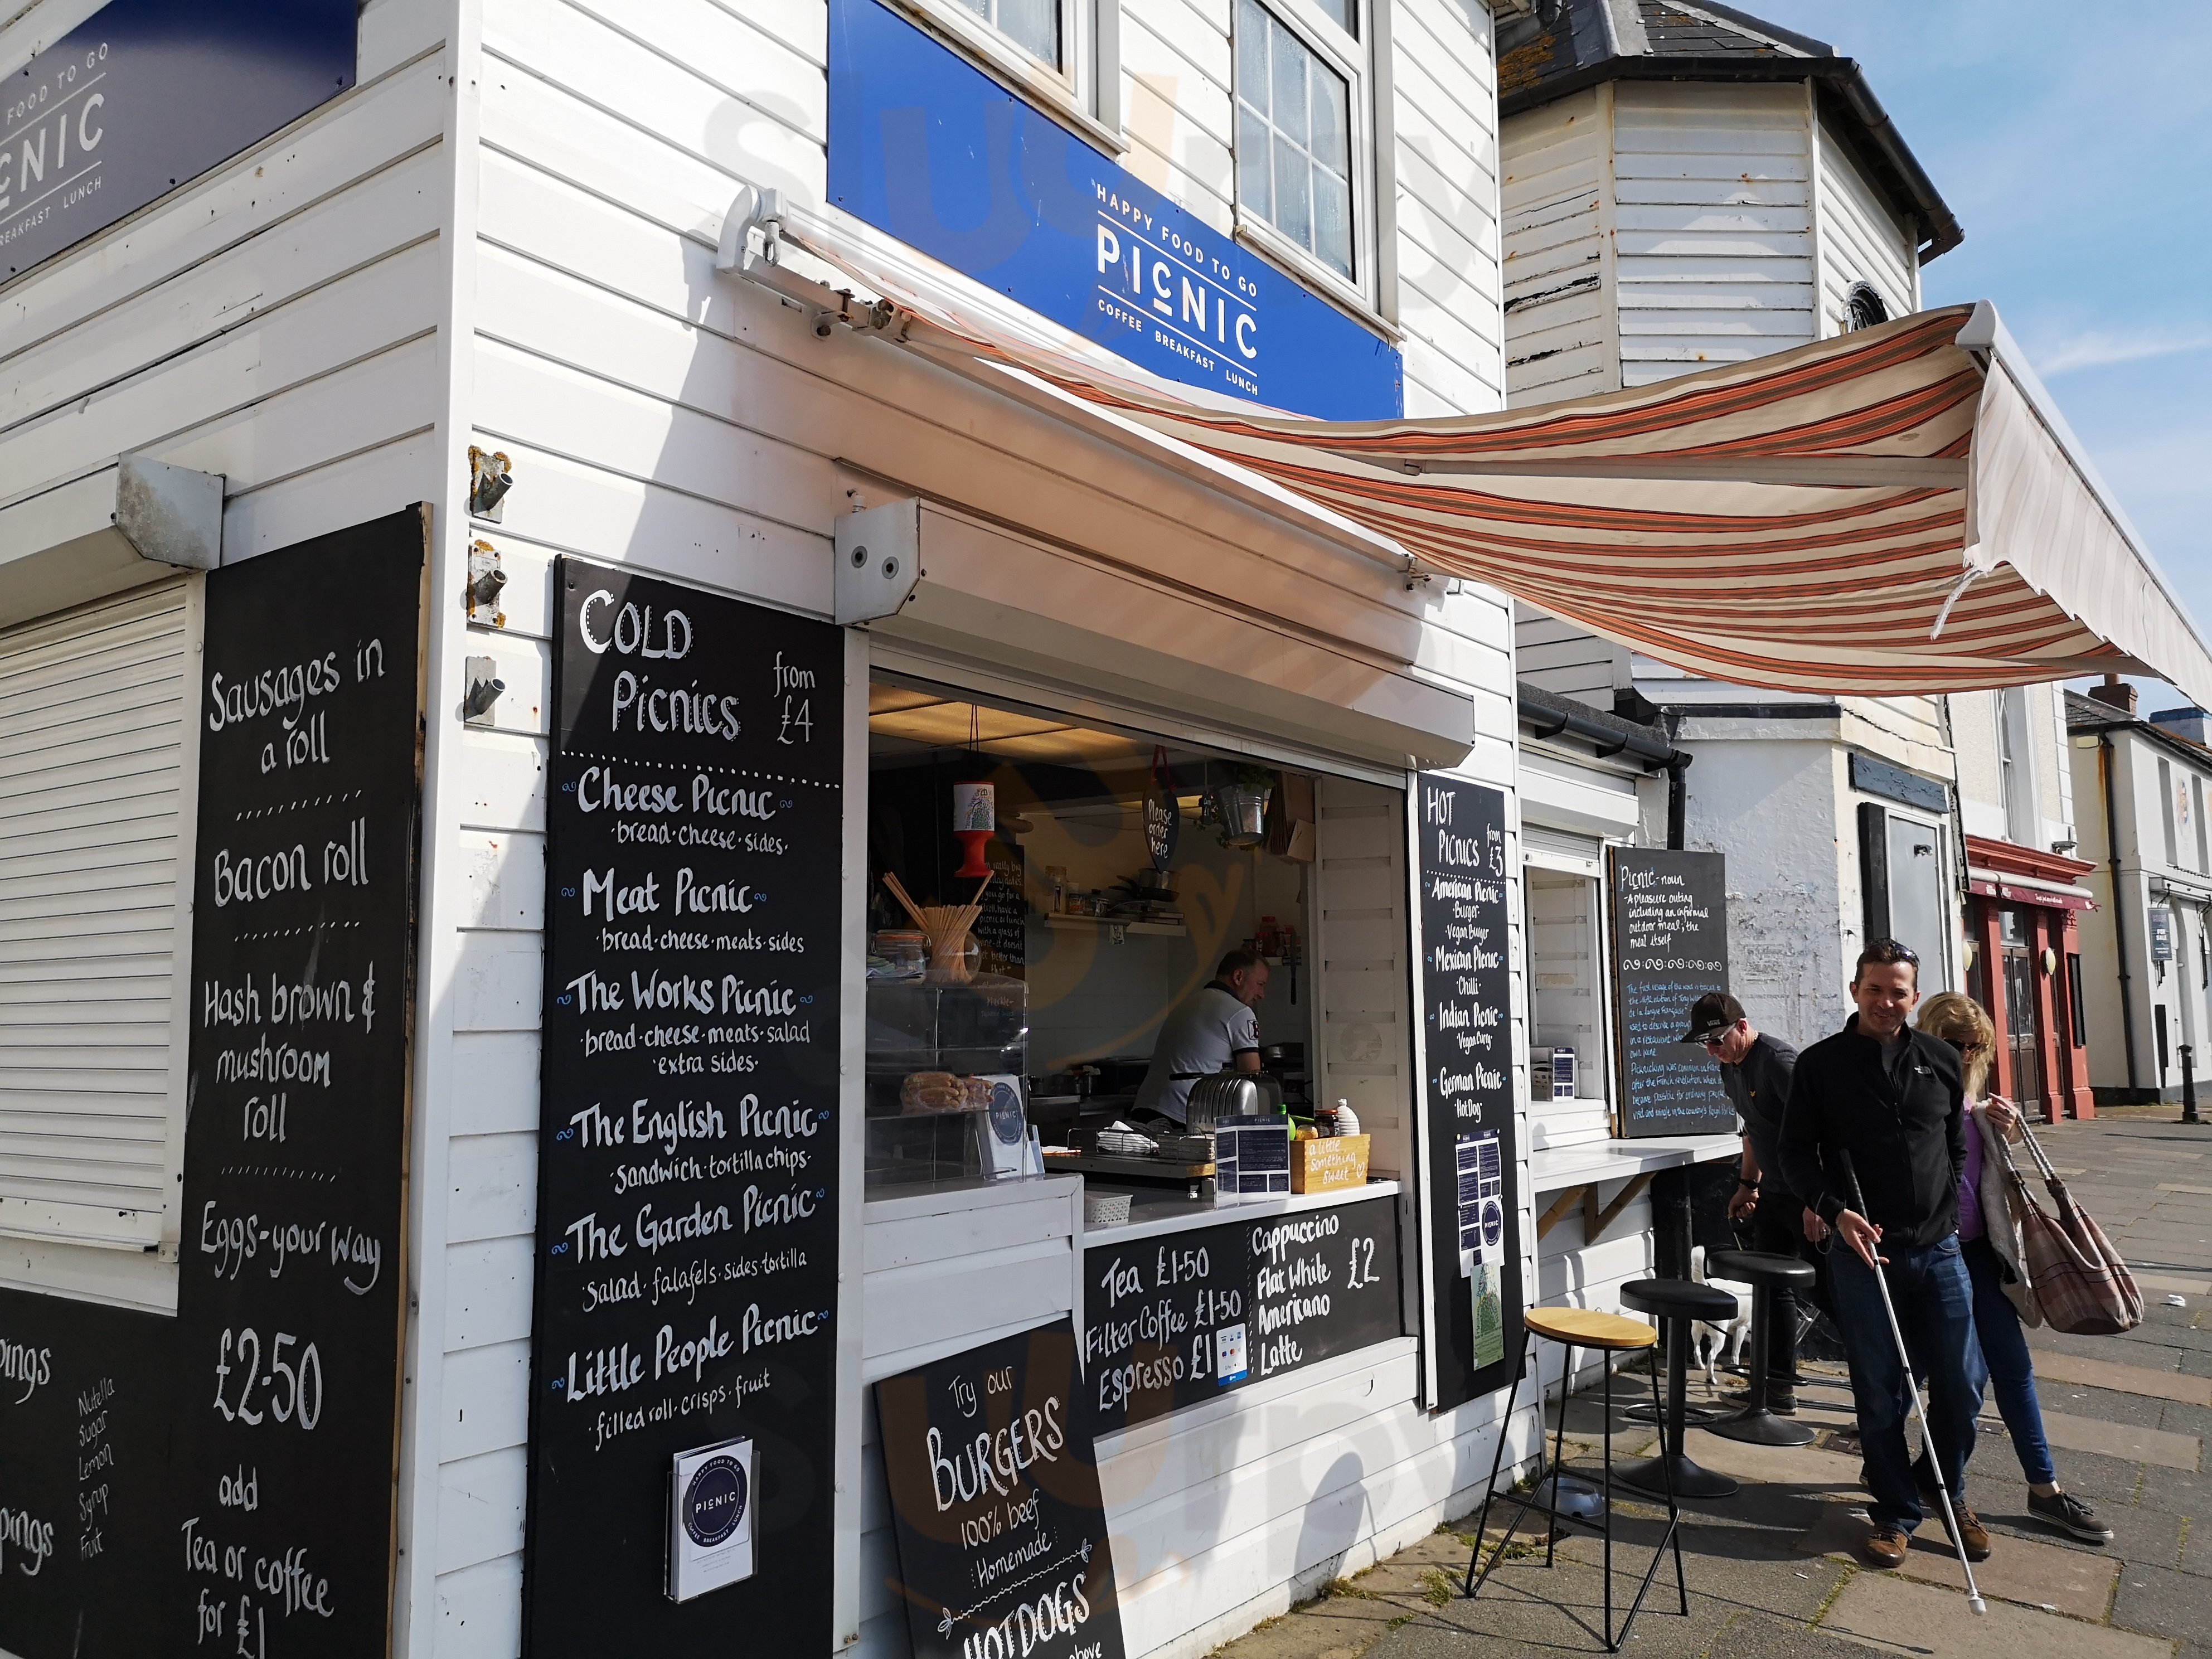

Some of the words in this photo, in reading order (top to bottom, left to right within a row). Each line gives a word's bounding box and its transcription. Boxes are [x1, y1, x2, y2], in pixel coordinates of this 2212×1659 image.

[7, 85, 47, 125] FOOD
[57, 65, 76, 90] TO
[86, 42, 108, 69] GO
[64, 176, 102, 209] LUNCH
[1097, 183, 1153, 231] HAPPY
[1162, 226, 1204, 264] FOOD
[1211, 258, 1230, 280] TO
[1238, 276, 1257, 297] GO
[1098, 224, 1257, 358] PICNIC
[1098, 299, 1142, 332] COFFEE
[1155, 330, 1215, 372] BREAKFAST
[1226, 370, 1258, 396] LUNCH
[210, 651, 340, 731] Sausages
[357, 638, 386, 682] in
[613, 671, 741, 741] Picnics
[773, 652, 816, 697] from
[777, 695, 813, 744] £4
[261, 743, 277, 774] a
[287, 710, 330, 769] roll
[578, 767, 683, 813] Cheese
[692, 774, 776, 820] Picnic
[1148, 799, 1171, 826] Please
[1428, 786, 1456, 826] HOT
[618, 820, 670, 843] bread
[678, 823, 736, 848] cheese
[1149, 823, 1168, 839] order
[1151, 840, 1168, 858] here
[1487, 823, 1501, 848] from
[215, 843, 312, 907] Bacon
[324, 817, 369, 886] roll
[1489, 846, 1503, 877] £3
[583, 867, 659, 922] Meat
[676, 867, 753, 916] Picnic
[1432, 876, 1472, 901] American
[1474, 881, 1500, 904] Picnic
[1634, 894, 1667, 908] pleasure
[1669, 891, 1692, 910] outing
[1454, 900, 1477, 923] Burger
[1629, 906, 1663, 922] including
[1677, 908, 1709, 923] informal
[1629, 921, 1656, 934] outdoor
[1686, 921, 1699, 931] the
[1447, 923, 1468, 945] Vegan
[1469, 924, 1489, 946] Burger
[1631, 935, 1646, 949] meal
[1651, 933, 1671, 953] itself
[1435, 945, 1472, 972] Mexican
[1473, 944, 1500, 972] Picnic
[205, 973, 261, 1028] Hash
[271, 972, 355, 1025] brown
[565, 970, 625, 1015] The
[631, 968, 715, 1014] Works
[721, 974, 796, 1017] Picnic
[1458, 976, 1478, 995] Chilli
[1439, 1000, 1470, 1031] Indian
[1473, 1002, 1498, 1028] Picnic
[216, 1032, 331, 1088] mushroom
[1458, 1031, 1476, 1055] Vegan
[1476, 1031, 1491, 1051] Curry
[1440, 1066, 1474, 1099] German
[1476, 1061, 1502, 1090] Picnic
[244, 1093, 286, 1143] roll
[569, 1102, 625, 1148] The
[632, 1098, 727, 1155] English
[740, 1094, 818, 1138] Picnic
[996, 1110, 1016, 1119] PICNIC
[1457, 1098, 1468, 1118] Hot
[1468, 1098, 1481, 1123] Dog
[710, 1149, 763, 1178] tortilla
[766, 1146, 807, 1176] chips
[1309, 1144, 1316, 1156] a
[1318, 1139, 1340, 1154] little
[1311, 1152, 1356, 1171] something
[1323, 1170, 1348, 1184] sweet
[565, 1212, 628, 1264] The
[636, 1201, 733, 1255] Garden
[744, 1183, 816, 1234] Picnic
[1253, 1214, 1339, 1265] Cappuccino
[1101, 1257, 1144, 1309] Tea
[1258, 1267, 1286, 1300] Flat
[1288, 1253, 1331, 1289] White
[1347, 1237, 1380, 1289] £2
[1086, 1319, 1138, 1363] Filter
[1139, 1298, 1189, 1350] Coffee
[1258, 1294, 1330, 1336] Americano
[567, 1343, 646, 1402] Little
[656, 1316, 734, 1382] People
[742, 1304, 818, 1354] Picnic
[1099, 1355, 1183, 1413] Espresso
[1190, 1333, 1212, 1382] £1
[1261, 1335, 1303, 1376] Latte
[78, 1377, 115, 1418] Nutella
[948, 1375, 977, 1418] Try
[987, 1366, 1013, 1394] our
[79, 1443, 114, 1482] Lemon
[927, 1396, 1064, 1512] BURGERS
[220, 1464, 258, 1511] add
[692, 1466, 707, 1486] HAPPY
[80, 1483, 108, 1531] Syrup
[696, 1492, 735, 1513] PICNIC
[962, 1506, 1002, 1550] 100%
[1008, 1488, 1040, 1530] beef
[703, 1529, 729, 1542] BREAKFAST
[732, 1505, 742, 1526] LUNCH
[182, 1517, 218, 1574] Tea
[225, 1545, 246, 1581] or
[255, 1547, 334, 1617] coffee
[977, 1531, 1052, 1587] Homemade
[197, 1588, 227, 1645] for
[237, 1595, 265, 1659] £1
